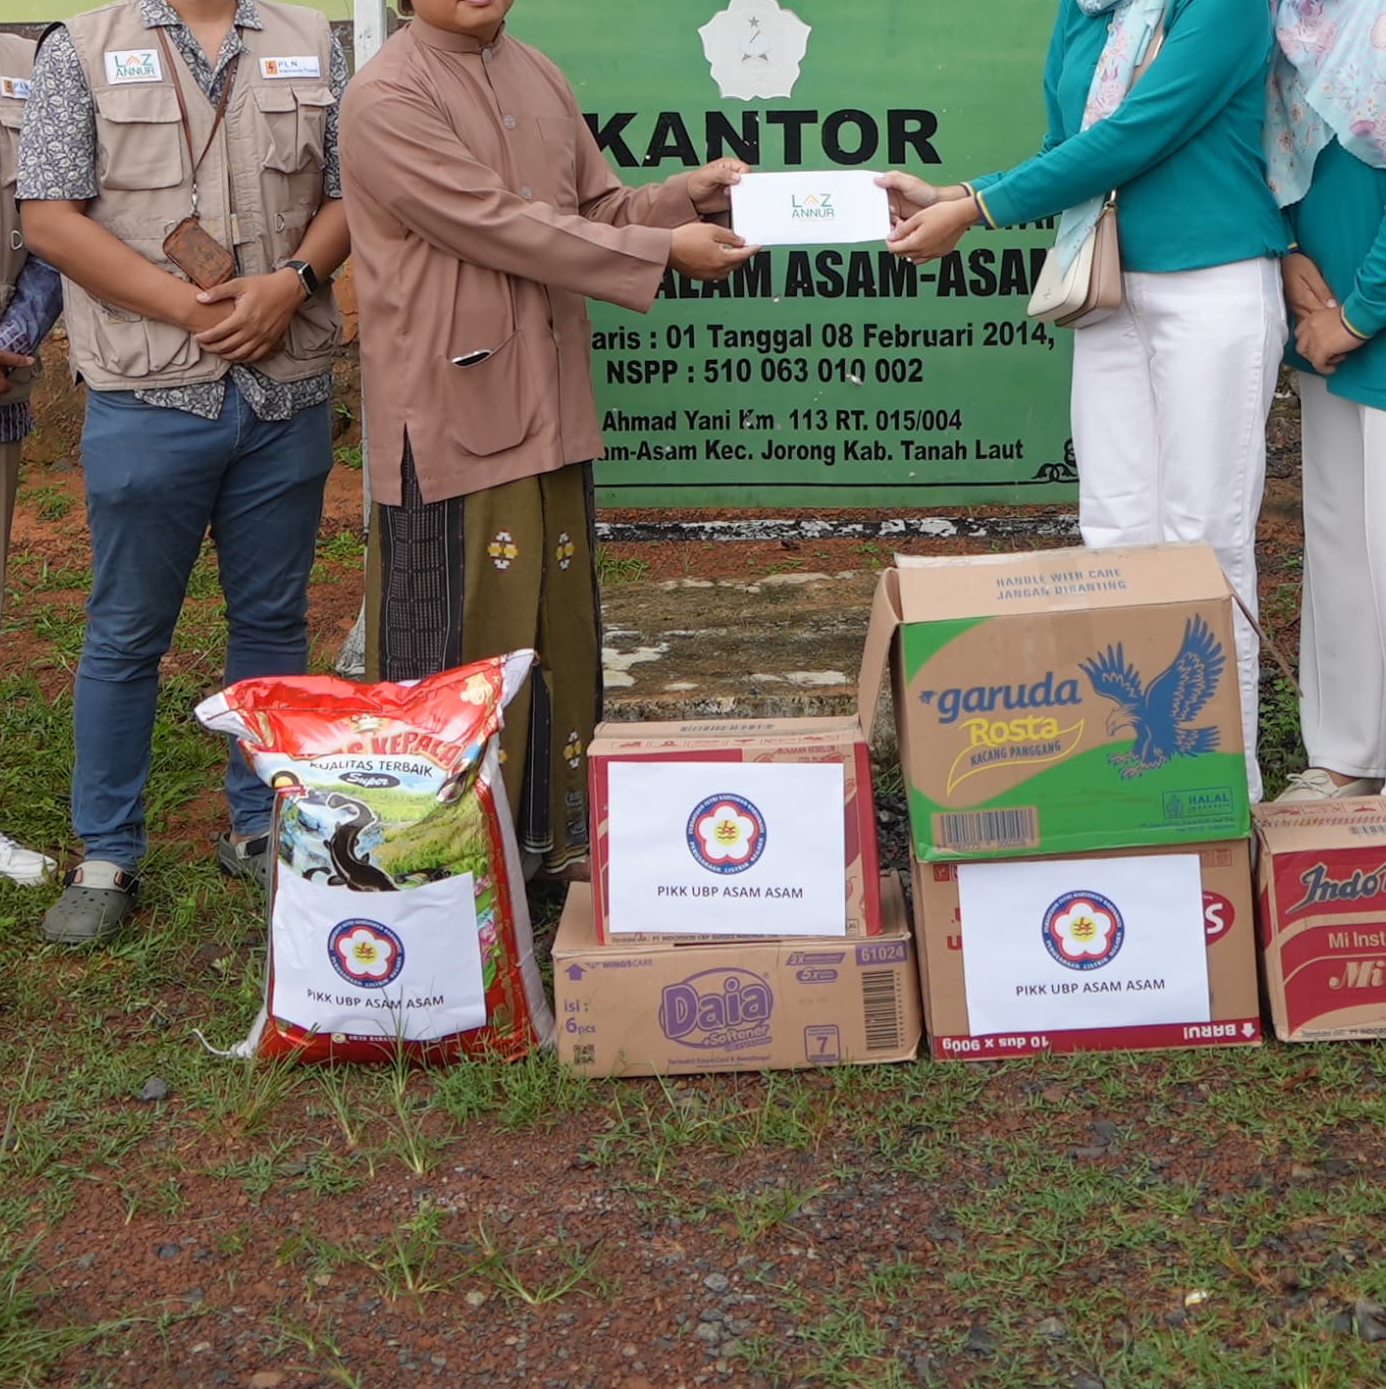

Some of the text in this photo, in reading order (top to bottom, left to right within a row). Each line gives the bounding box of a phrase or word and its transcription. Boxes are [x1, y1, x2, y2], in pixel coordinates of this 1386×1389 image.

[116, 66, 155, 77] ANNUR
[582, 109, 942, 168] KANTOR
[791, 207, 835, 219] ANNUR
[592, 328, 641, 350] aris
[666, 327, 696, 349] 01
[707, 324, 812, 354] Tanggal
[821, 324, 854, 348] 08
[864, 323, 974, 348] Februari
[983, 320, 1055, 350] 2014,
[606, 360, 678, 385] NSPP
[704, 358, 752, 383] 510
[763, 358, 809, 383] 063
[818, 359, 864, 383] 010
[875, 358, 923, 383] 002
[602, 409, 677, 432] Ahmad
[684, 409, 731, 431] Yani
[789, 408, 828, 431] 113
[836, 408, 869, 430] RT.
[875, 407, 962, 431] 015/004
[705, 439, 754, 461] Kec.
[761, 438, 835, 466] Jorong
[843, 439, 894, 462] Kab.
[901, 439, 967, 461] Tanah
[975, 438, 1023, 460] Laut
[996, 568, 1122, 588] HANDLE WITH CARE
[997, 587, 1050, 600] JANGAN
[937, 671, 1083, 724] garuda
[958, 715, 1059, 747] Rosta
[371, 731, 464, 767] KEPALA
[971, 740, 1061, 766] KACANG PANGGANG
[378, 760, 433, 778] TERBAIK
[346, 772, 390, 787] Super
[1189, 793, 1230, 805] HALAL
[657, 886, 803, 899] PIKK UBP ASAM ASAM
[1329, 934, 1351, 949] Mi
[861, 946, 905, 962] 61024
[1015, 979, 1165, 997] PIKK UBP ASAM ASAM
[307, 988, 445, 1010] PIKK UBP ASAM ASAM
[661, 976, 771, 1040] Daia
[1183, 1023, 1236, 1039] BARU!
[816, 1036, 828, 1053] 7
[942, 1035, 1050, 1052] 10 dus x 900g
